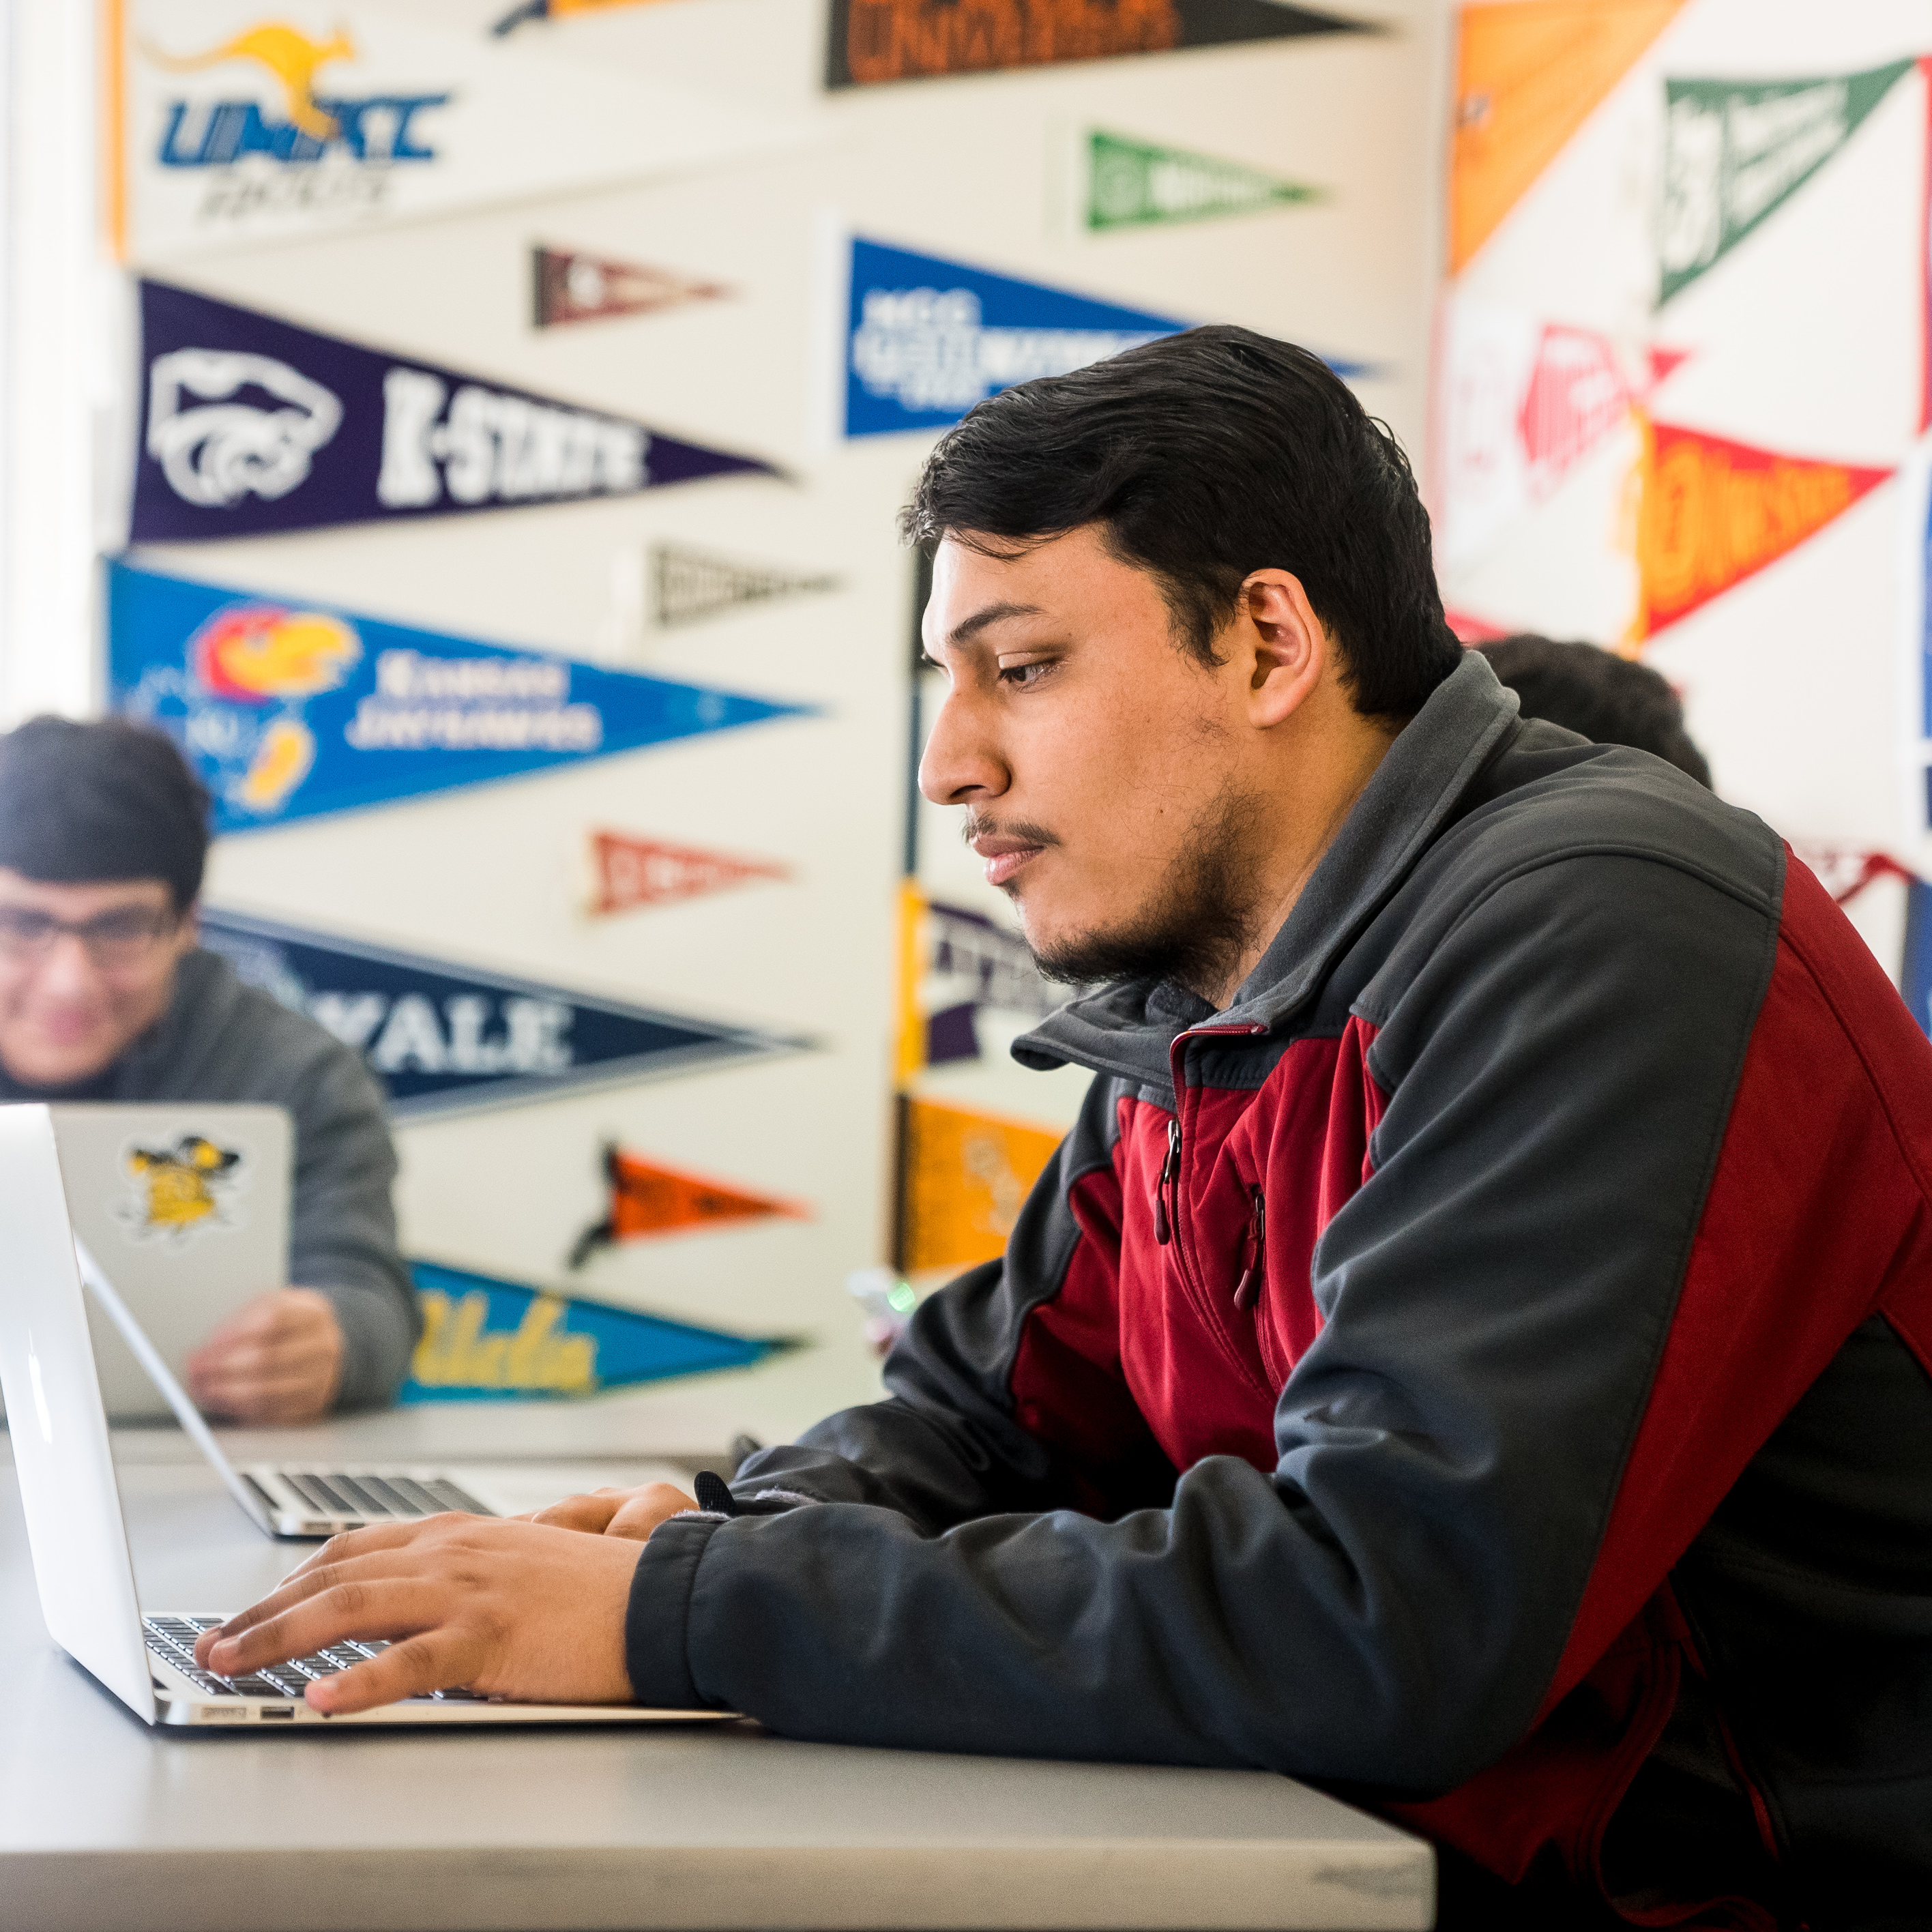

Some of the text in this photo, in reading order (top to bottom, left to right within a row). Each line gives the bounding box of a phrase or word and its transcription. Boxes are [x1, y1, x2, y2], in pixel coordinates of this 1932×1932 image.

[379, 366, 649, 508] K-STATE
[378, 649, 569, 700] KANSAS
[312, 993, 573, 1074] YALE
